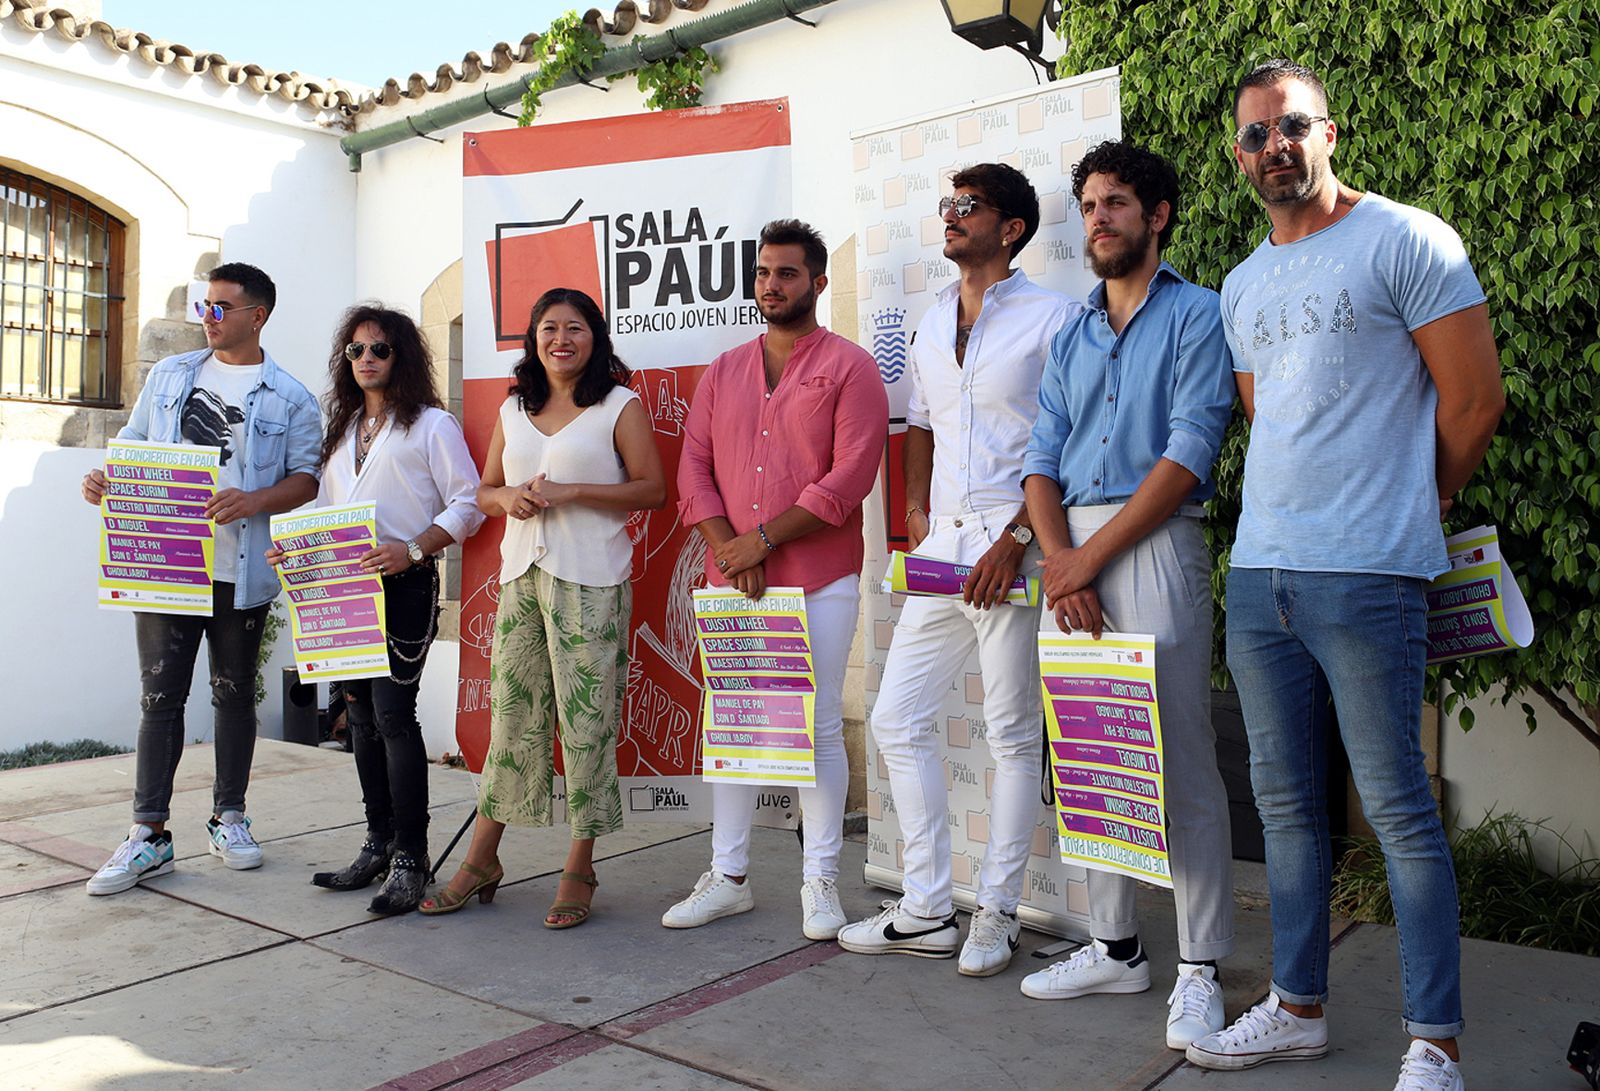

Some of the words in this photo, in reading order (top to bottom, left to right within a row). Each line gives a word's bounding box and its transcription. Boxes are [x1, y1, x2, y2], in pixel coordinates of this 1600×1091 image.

[615, 207, 707, 248] SALA
[617, 312, 676, 334] ESPACIO
[680, 307, 726, 330] JOVEN
[112, 448, 123, 460] DE
[125, 448, 178, 464] CONCIERTOS
[181, 453, 192, 466] EN
[113, 465, 141, 478] DUSTY
[143, 468, 175, 480] WHEEL
[110, 482, 136, 496] SPACE
[138, 486, 169, 498] SURIMI
[111, 501, 144, 512] MAESTRO
[145, 504, 180, 515] MUTANTE
[118, 520, 150, 532] MIGUEL
[274, 524, 287, 535] DE
[287, 514, 336, 532] CONCIERTOS
[338, 512, 350, 524] EN
[110, 538, 138, 548] MANUEL
[139, 540, 148, 549] DE
[149, 541, 160, 550] PAY
[280, 536, 306, 552] DUSTY
[305, 532, 336, 547] WHEEL
[112, 551, 125, 560] SON
[135, 552, 166, 563] SANTIAGO
[283, 556, 309, 569] SPACE
[307, 550, 337, 564] SURIMI
[288, 571, 322, 583] MAESTRO
[321, 566, 350, 578] MUTANTE
[301, 587, 330, 599] MIGUEL
[1439, 584, 1491, 606] GHOULJABOY
[300, 608, 322, 617] MANUEL
[322, 607, 330, 615] DE
[330, 606, 342, 614] PAY
[699, 599, 711, 612] DE
[714, 598, 768, 612] CONCIERTOS
[770, 598, 780, 611] EN
[320, 618, 347, 629] SANTIAGO
[704, 618, 736, 631] DUSTY
[736, 617, 769, 630] WHEEL
[1472, 612, 1488, 626] SON
[705, 639, 735, 651] SPACE
[735, 638, 767, 650] SURIMI
[1432, 639, 1449, 654] PAY
[1452, 636, 1463, 650] DE
[1462, 632, 1499, 648] MANUEL
[710, 658, 745, 668] MAESTRO
[745, 658, 779, 668] MUTANTE
[721, 677, 754, 689] MIGUEL
[716, 699, 742, 709] MANUEL
[743, 700, 752, 709] DE
[753, 700, 765, 709] PAY
[716, 714, 729, 723] SON
[739, 713, 770, 725] SANTIAGO
[1096, 705, 1127, 720] SANTIAGO
[1134, 710, 1148, 723] SON
[1104, 724, 1116, 736] PAY
[1116, 726, 1125, 738] DE
[1125, 727, 1151, 742] MANUEL
[1116, 750, 1147, 770] MIGUEL
[1090, 773, 1124, 789] MUTANTE
[1123, 778, 1155, 796] MAESTRO
[656, 791, 688, 806] PAÚL
[1104, 796, 1132, 818] SURIMI
[1133, 801, 1158, 823] SPACE
[1101, 820, 1130, 840] WHEEL
[1131, 826, 1159, 849] DUSTY
[1087, 840, 1100, 856] EN
[1102, 842, 1152, 870] CONCIERTOS
[1154, 857, 1165, 874] DE
